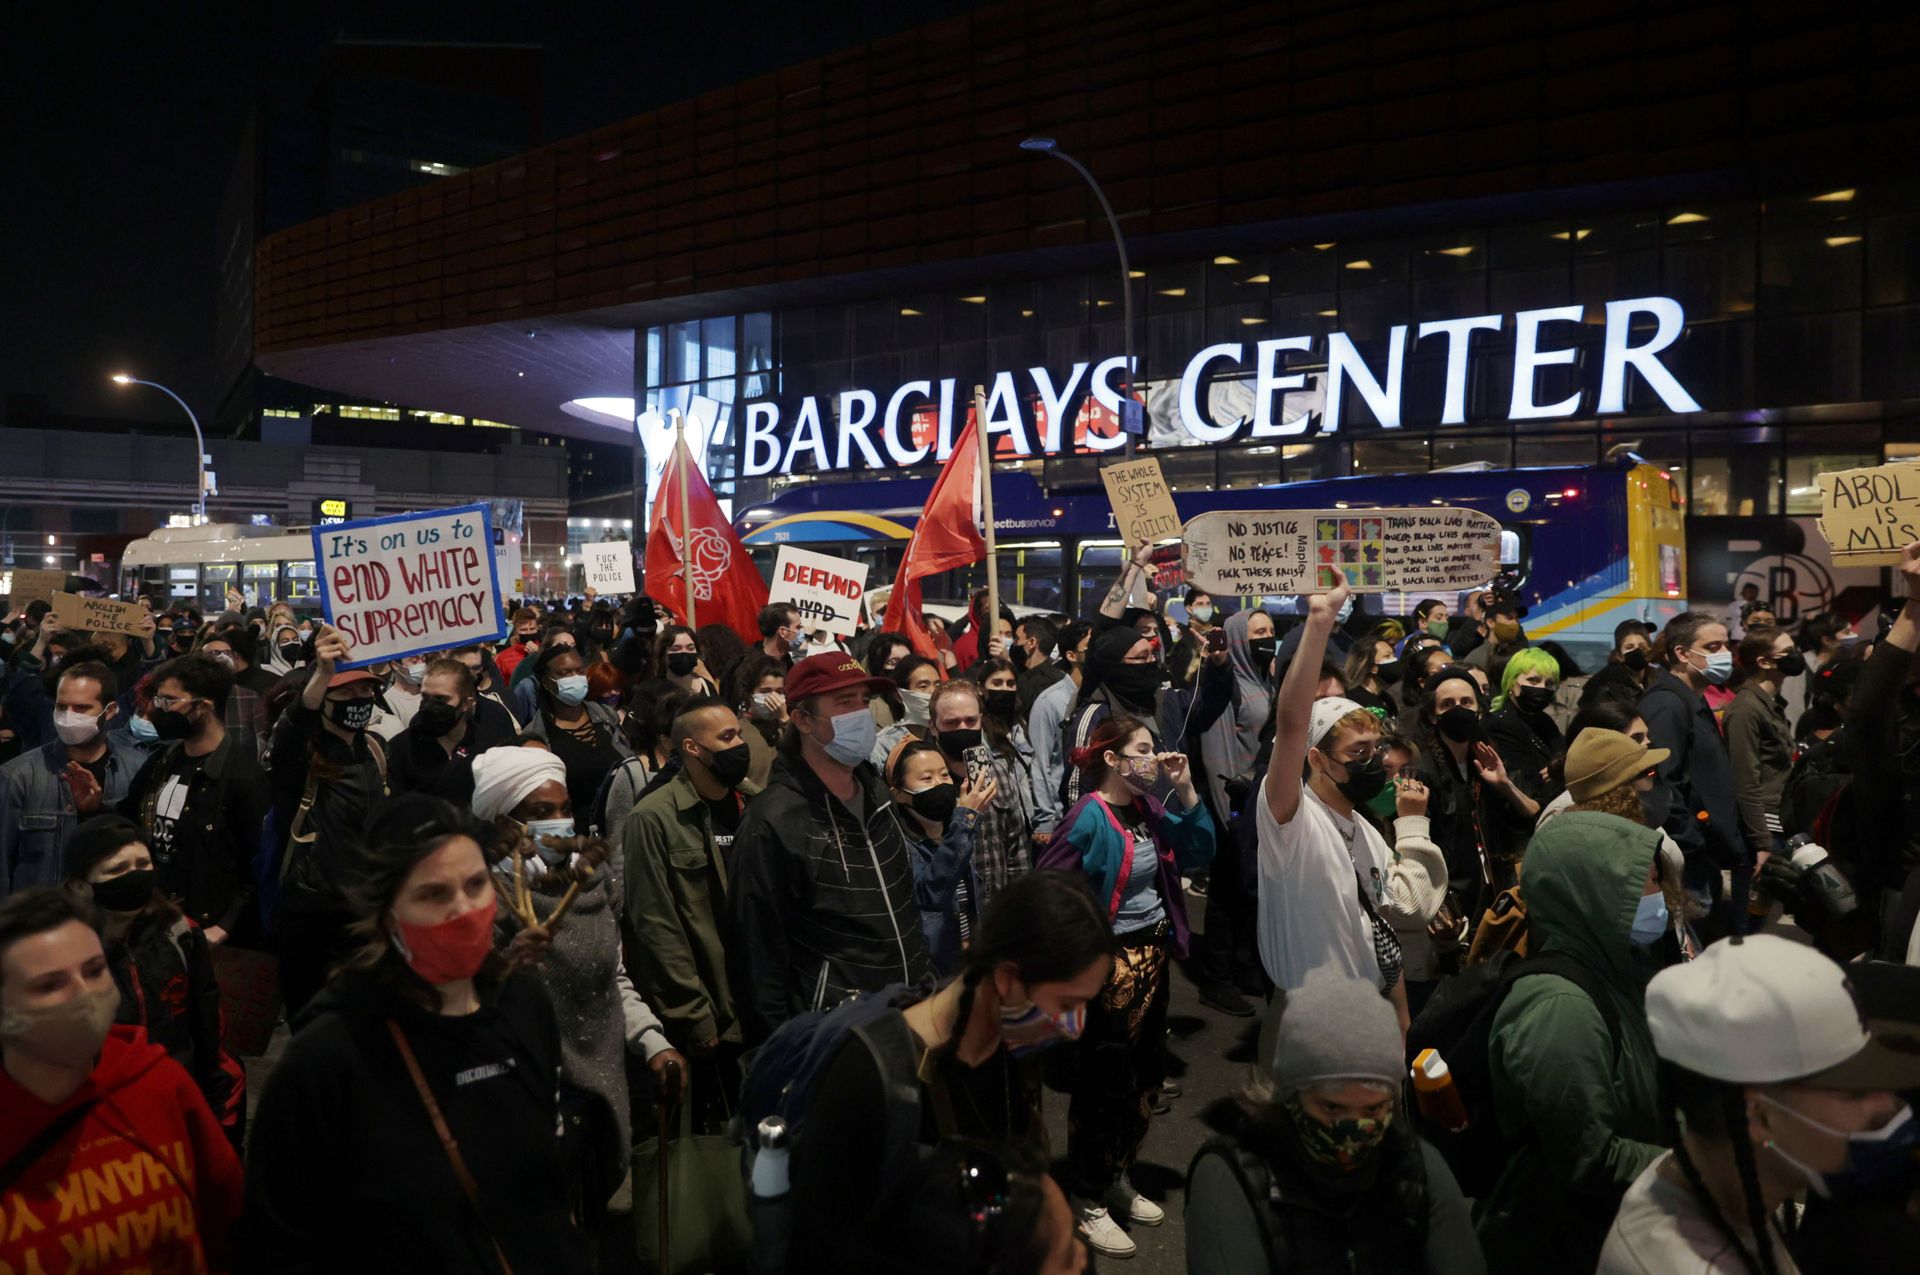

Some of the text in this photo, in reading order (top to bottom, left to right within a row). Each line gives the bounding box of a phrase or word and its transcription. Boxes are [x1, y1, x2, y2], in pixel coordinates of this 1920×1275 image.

[742, 296, 1702, 476] BARCLAYS CENTER
[1107, 465, 1158, 486] THE WHOLE
[1118, 482, 1165, 504] SYSTEM
[1833, 468, 1920, 510] ABOL
[1134, 503, 1148, 518] IS
[1874, 506, 1898, 525] IS
[980, 518, 1056, 530] sectbusservice
[1130, 514, 1176, 539] GUILTY
[1228, 521, 1298, 537] NO JUSTICE
[1386, 517, 1416, 529] TRANS
[330, 518, 473, 559] It's on us to
[595, 553, 618, 564] FUCK
[1229, 545, 1246, 562] NO
[1250, 542, 1288, 561] PEACE!
[1295, 535, 1308, 572] Maple
[599, 562, 614, 572] THE
[1217, 568, 1240, 581] FUCK
[1242, 567, 1274, 578] THESE
[592, 572, 623, 582] POLICE
[783, 561, 863, 601] DEFUND
[1386, 579, 1400, 587] ALL
[1235, 582, 1254, 594] ASS
[83, 601, 127, 613] ABOLISH
[790, 597, 836, 622] NYPD
[94, 611, 119, 621] THE
[86, 619, 133, 631] POLICE
[346, 704, 371, 713] BLAC
[0, 1192, 46, 1246] Y
